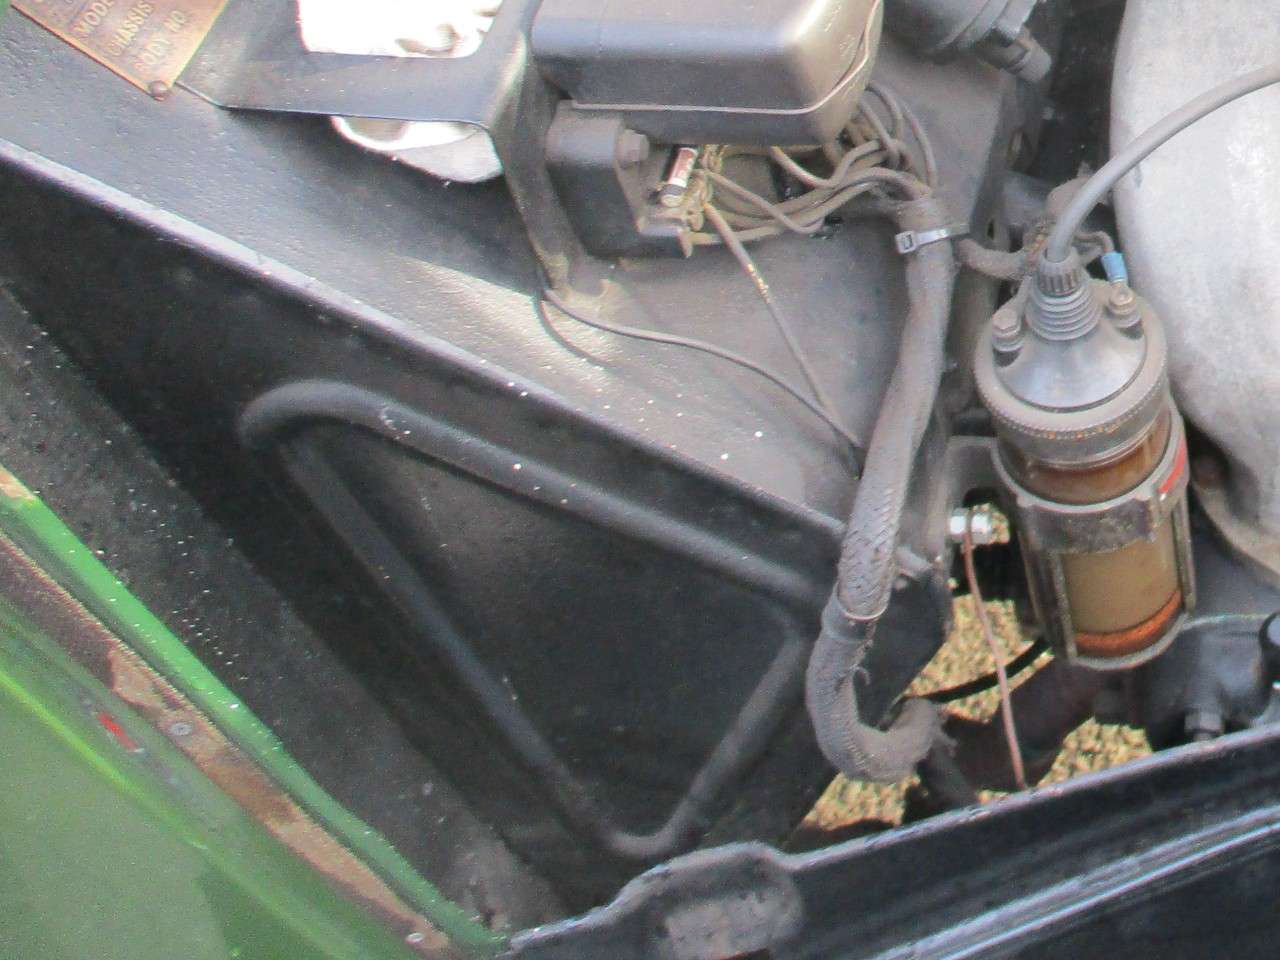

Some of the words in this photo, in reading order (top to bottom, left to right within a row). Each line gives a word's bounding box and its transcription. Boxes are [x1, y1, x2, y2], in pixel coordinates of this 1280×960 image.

[109, 0, 153, 56] CHASSIS
[134, 34, 172, 71] BODY
[163, 10, 187, 33] NO
